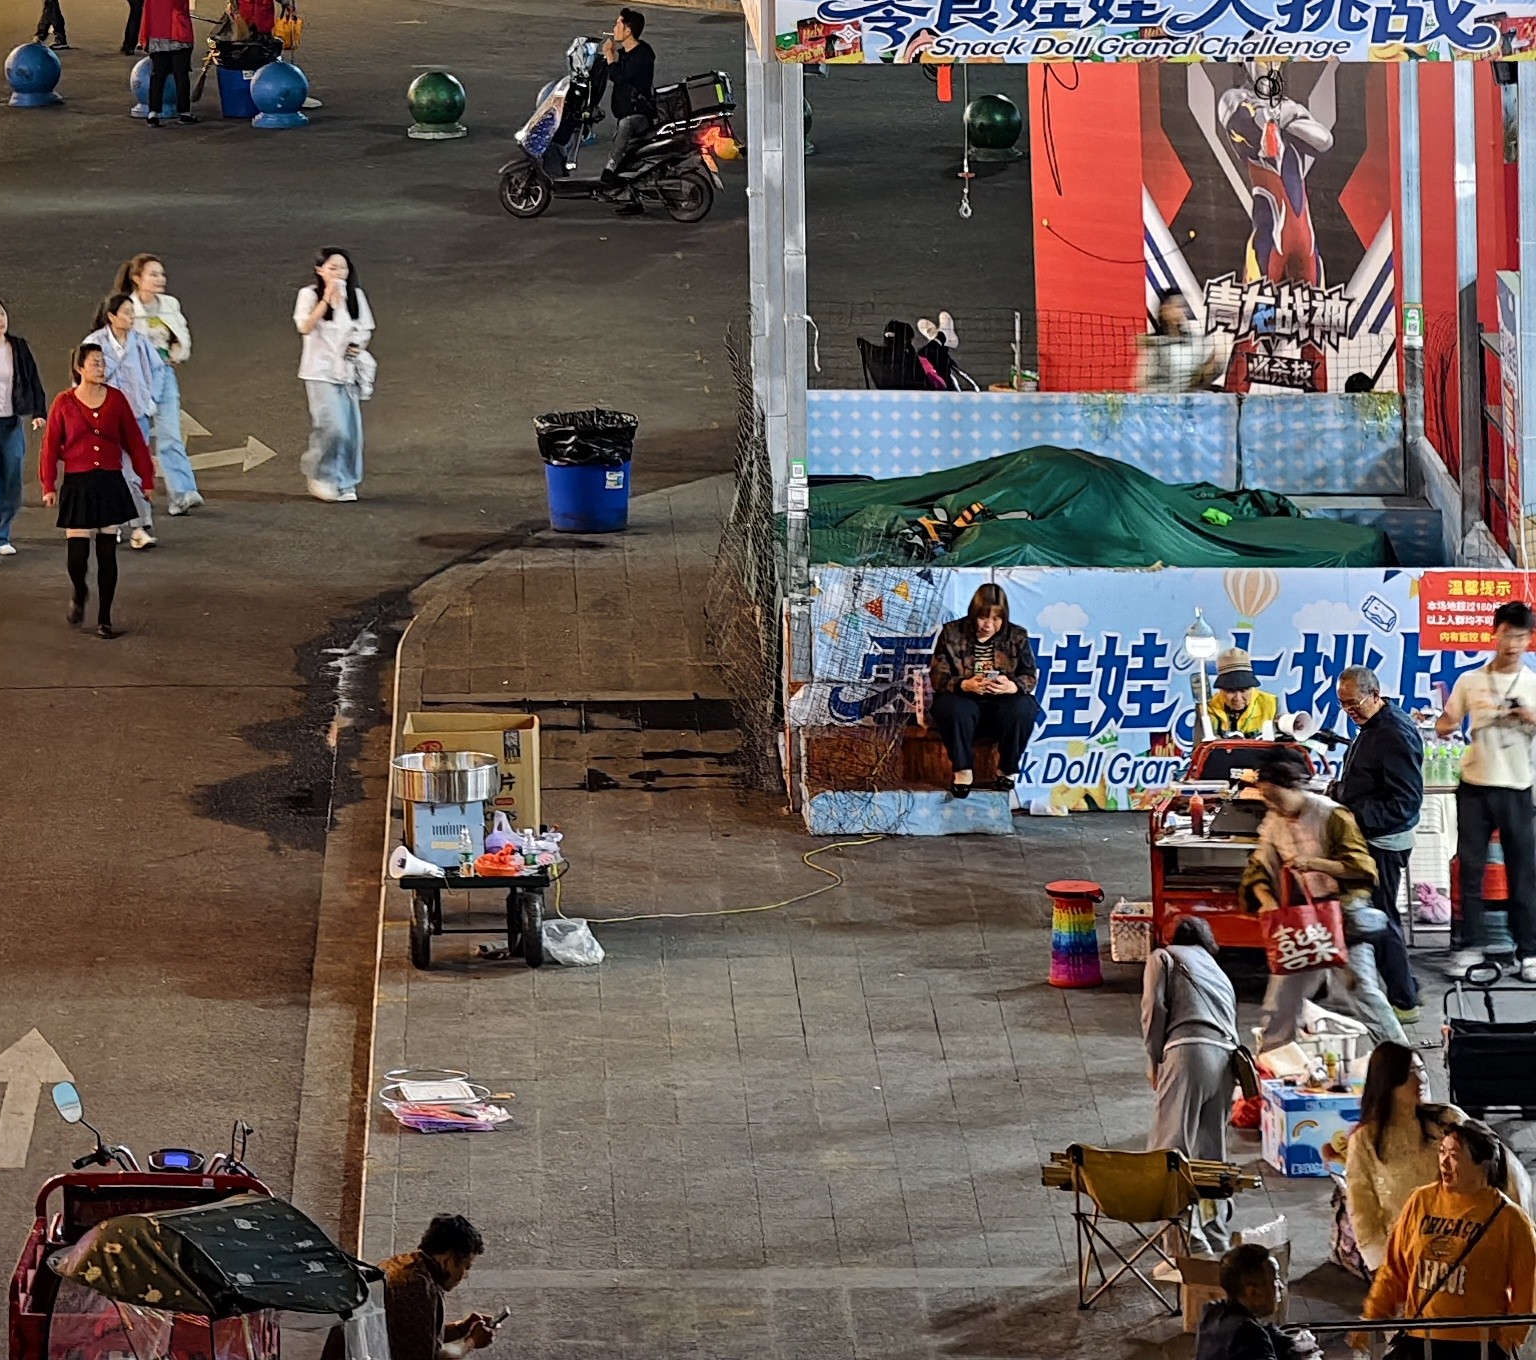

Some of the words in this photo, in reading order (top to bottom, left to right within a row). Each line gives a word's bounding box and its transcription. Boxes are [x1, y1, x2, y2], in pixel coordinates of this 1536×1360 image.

[931, 34, 1025, 57] Snack
[1031, 33, 1094, 56] Doll
[1100, 33, 1194, 56] Grand
[1199, 33, 1352, 61] Challenge
[1448, 579, 1511, 597] 温馨提示
[1042, 750, 1102, 785] Doll
[1108, 750, 1186, 786] Gran
